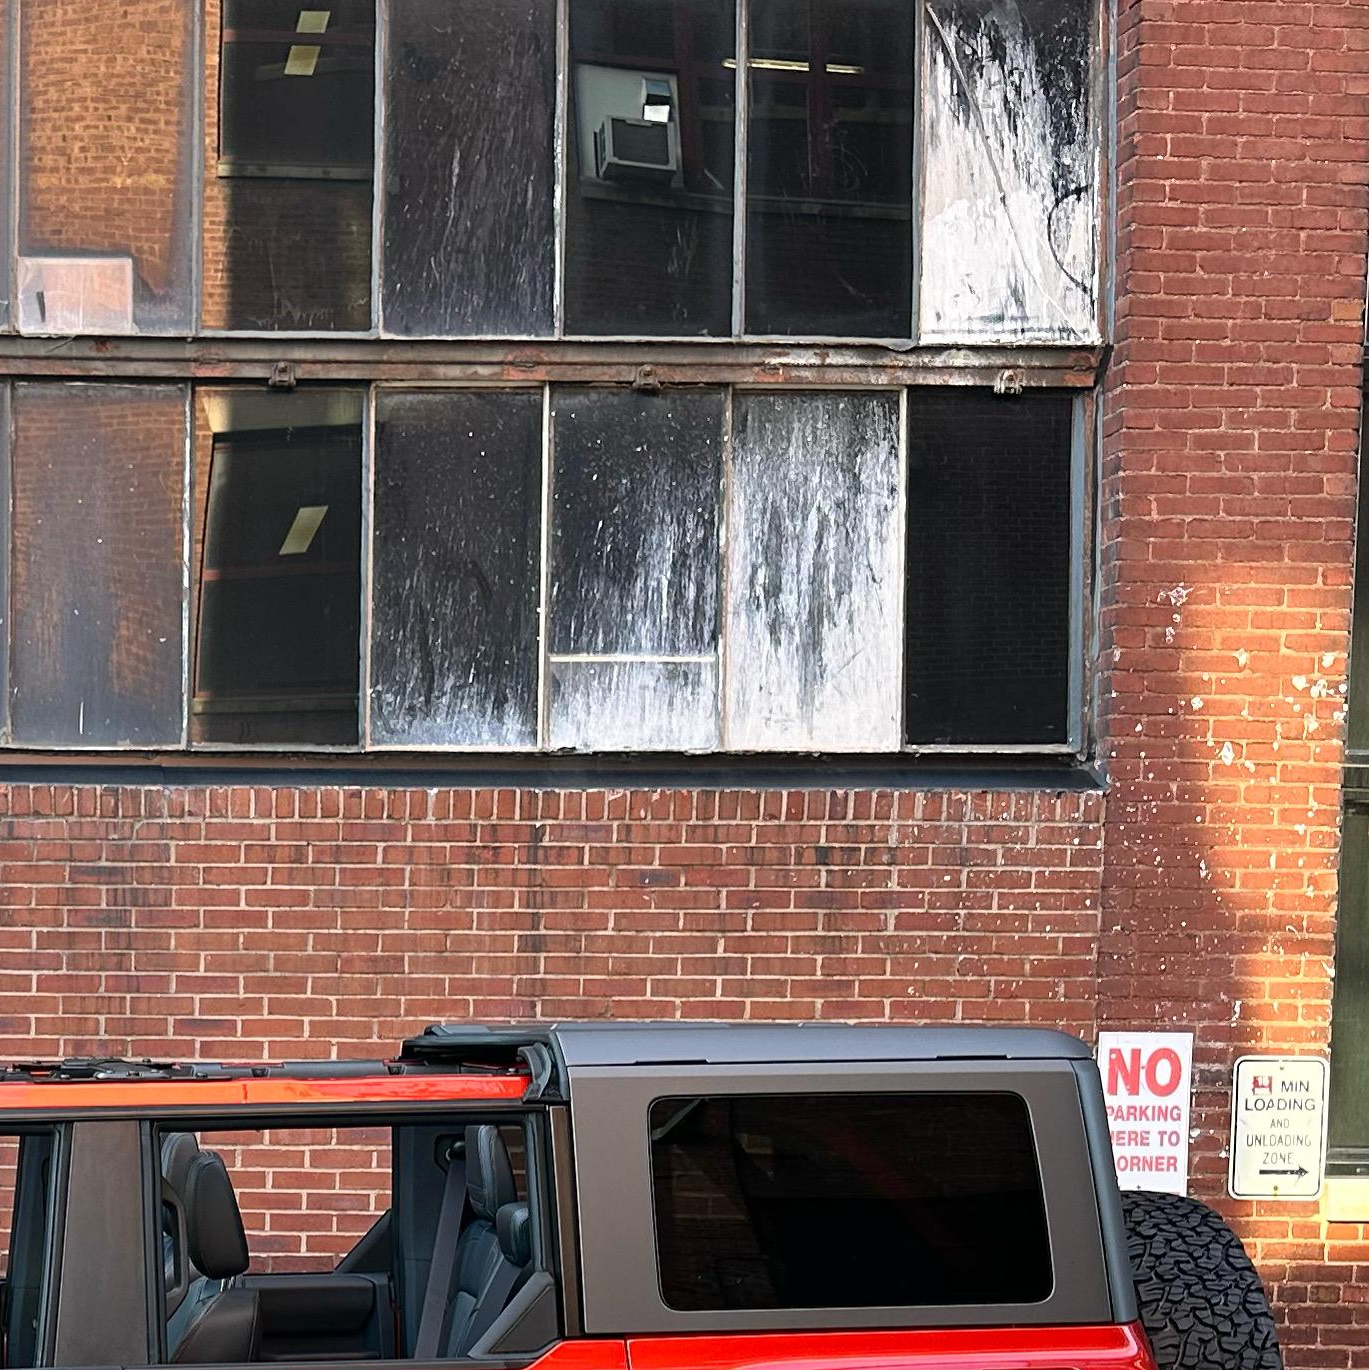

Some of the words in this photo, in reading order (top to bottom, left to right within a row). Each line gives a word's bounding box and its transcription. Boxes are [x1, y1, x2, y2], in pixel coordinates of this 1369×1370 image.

[1107, 1047, 1182, 1097] NO
[1281, 1080, 1310, 1093] MIN
[1245, 1098, 1316, 1111] LOADING
[1270, 1119, 1290, 1128] AND
[1157, 1130, 1181, 1147] TO
[1246, 1133, 1312, 1147] UNLOADING
[1116, 1155, 1178, 1172] ORNER
[1262, 1152, 1294, 1165] ZONE
